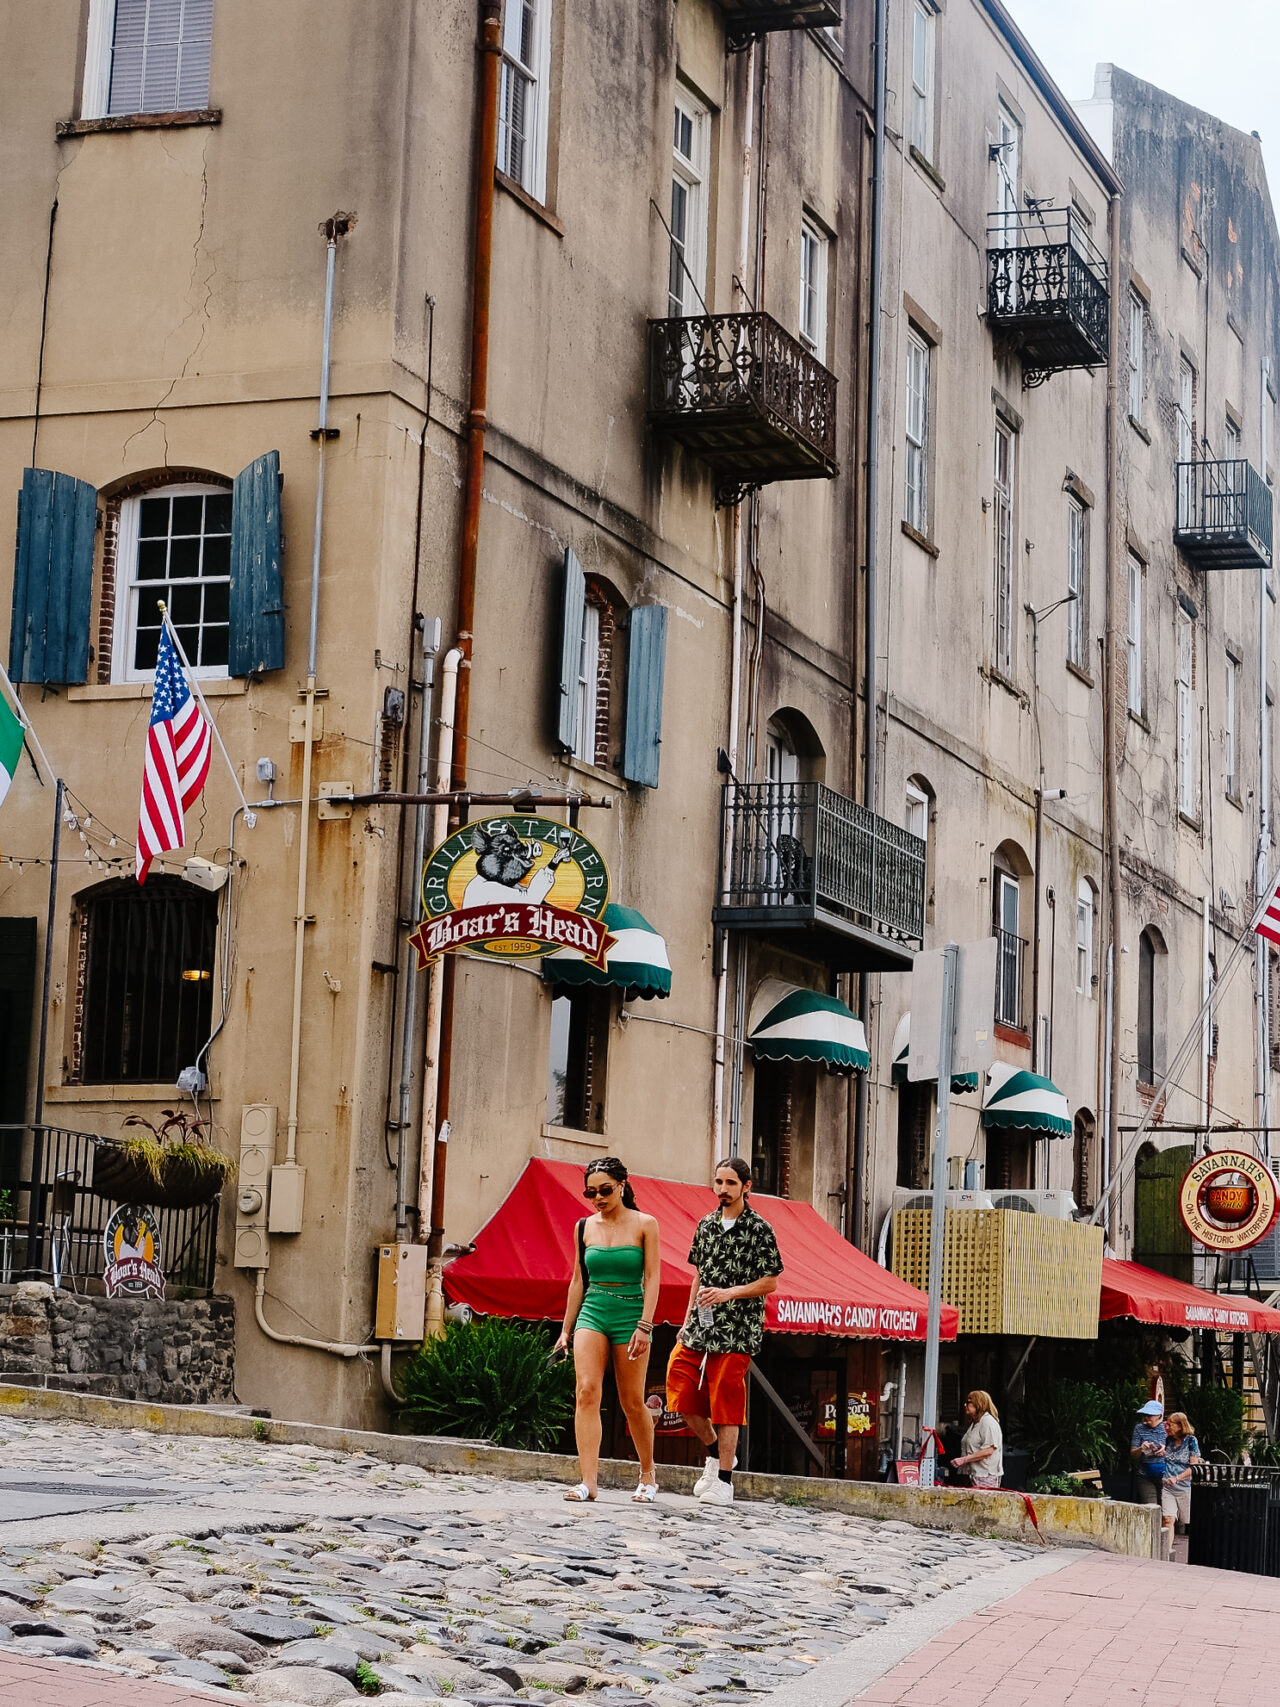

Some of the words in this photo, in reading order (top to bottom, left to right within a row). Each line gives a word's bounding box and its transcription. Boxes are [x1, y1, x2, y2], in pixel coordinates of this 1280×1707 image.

[427, 833, 472, 913] GRILL
[523, 820, 604, 914] TAVERN
[426, 906, 520, 954] Boar's
[526, 905, 598, 951] Head
[510, 942, 532, 951] 1959
[1191, 1155, 1265, 1182] SAVANNAH'S
[1209, 1189, 1243, 1201] CANDY
[1186, 1203, 1195, 1215] ON
[1190, 1216, 1203, 1232] THE
[1237, 1203, 1270, 1242] WATERFRONT
[1201, 1229, 1235, 1245] HISTORIC
[110, 1259, 138, 1287] Boar's
[140, 1260, 161, 1288] Head
[777, 1299, 842, 1327] SAVANNAH'S
[844, 1306, 877, 1328] CANDY
[879, 1308, 918, 1331] KITCHEN
[824, 1402, 870, 1419] Pocorn
